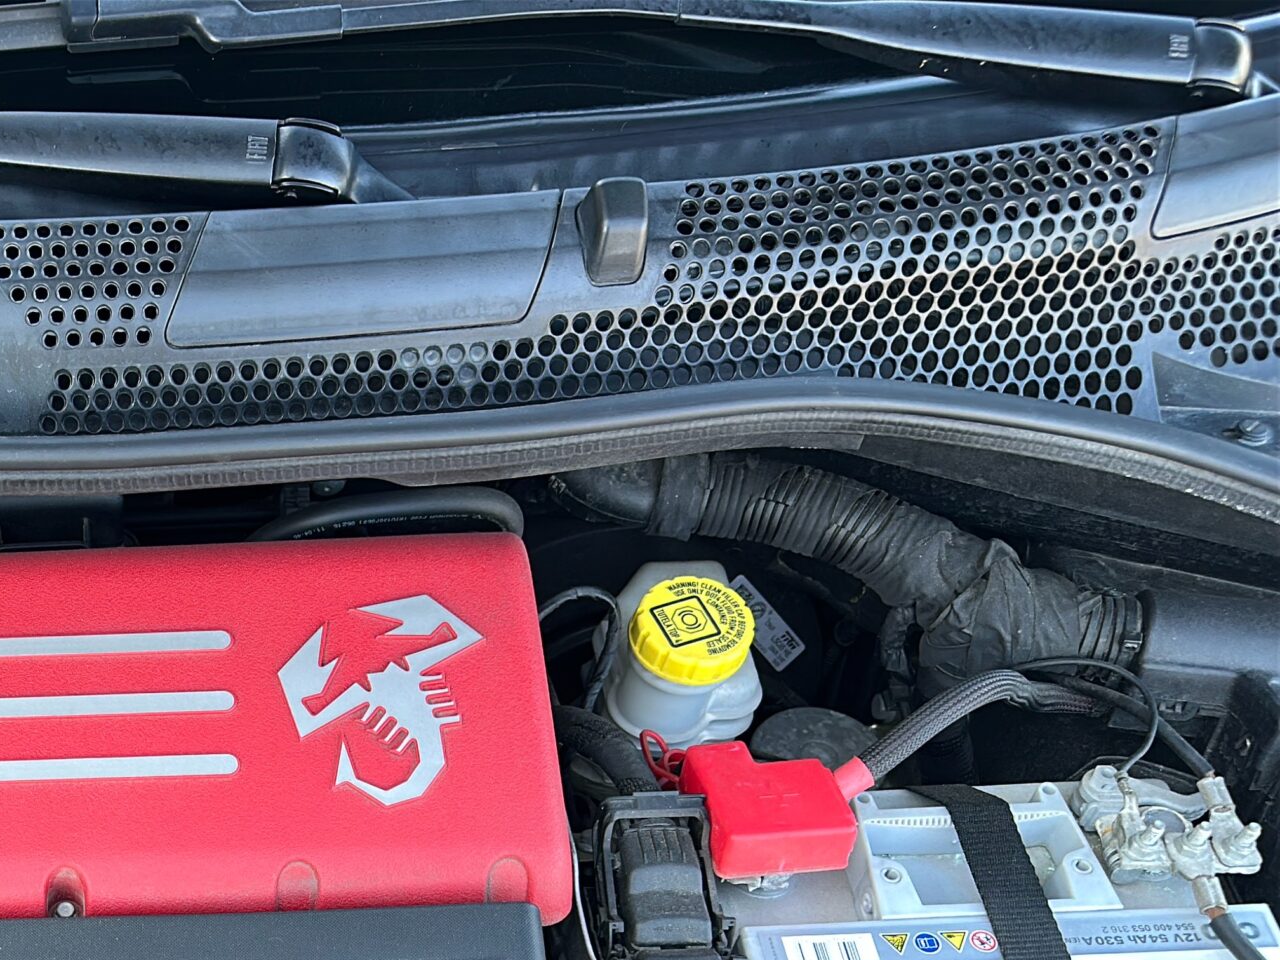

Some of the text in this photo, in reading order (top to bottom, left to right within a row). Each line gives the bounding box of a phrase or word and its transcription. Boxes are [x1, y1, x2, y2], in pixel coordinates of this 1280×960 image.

[245, 135, 268, 160] FIAT
[706, 598, 728, 625] CONTAINER
[720, 600, 735, 615] FLUID
[656, 608, 673, 628] TUTELA
[668, 627, 681, 639] TOP
[666, 582, 746, 656] WARNING! CLEAN FILLER CAP BEFORE REMOVING
[729, 615, 737, 631] FROM
[706, 634, 730, 647] SEALED
[1110, 924, 1128, 934] 316
[1131, 923, 1150, 933] 053
[1153, 922, 1173, 932] 400
[1175, 922, 1195, 932] 554
[1127, 933, 1167, 944] 54Ah
[1173, 931, 1202, 943] 12V
